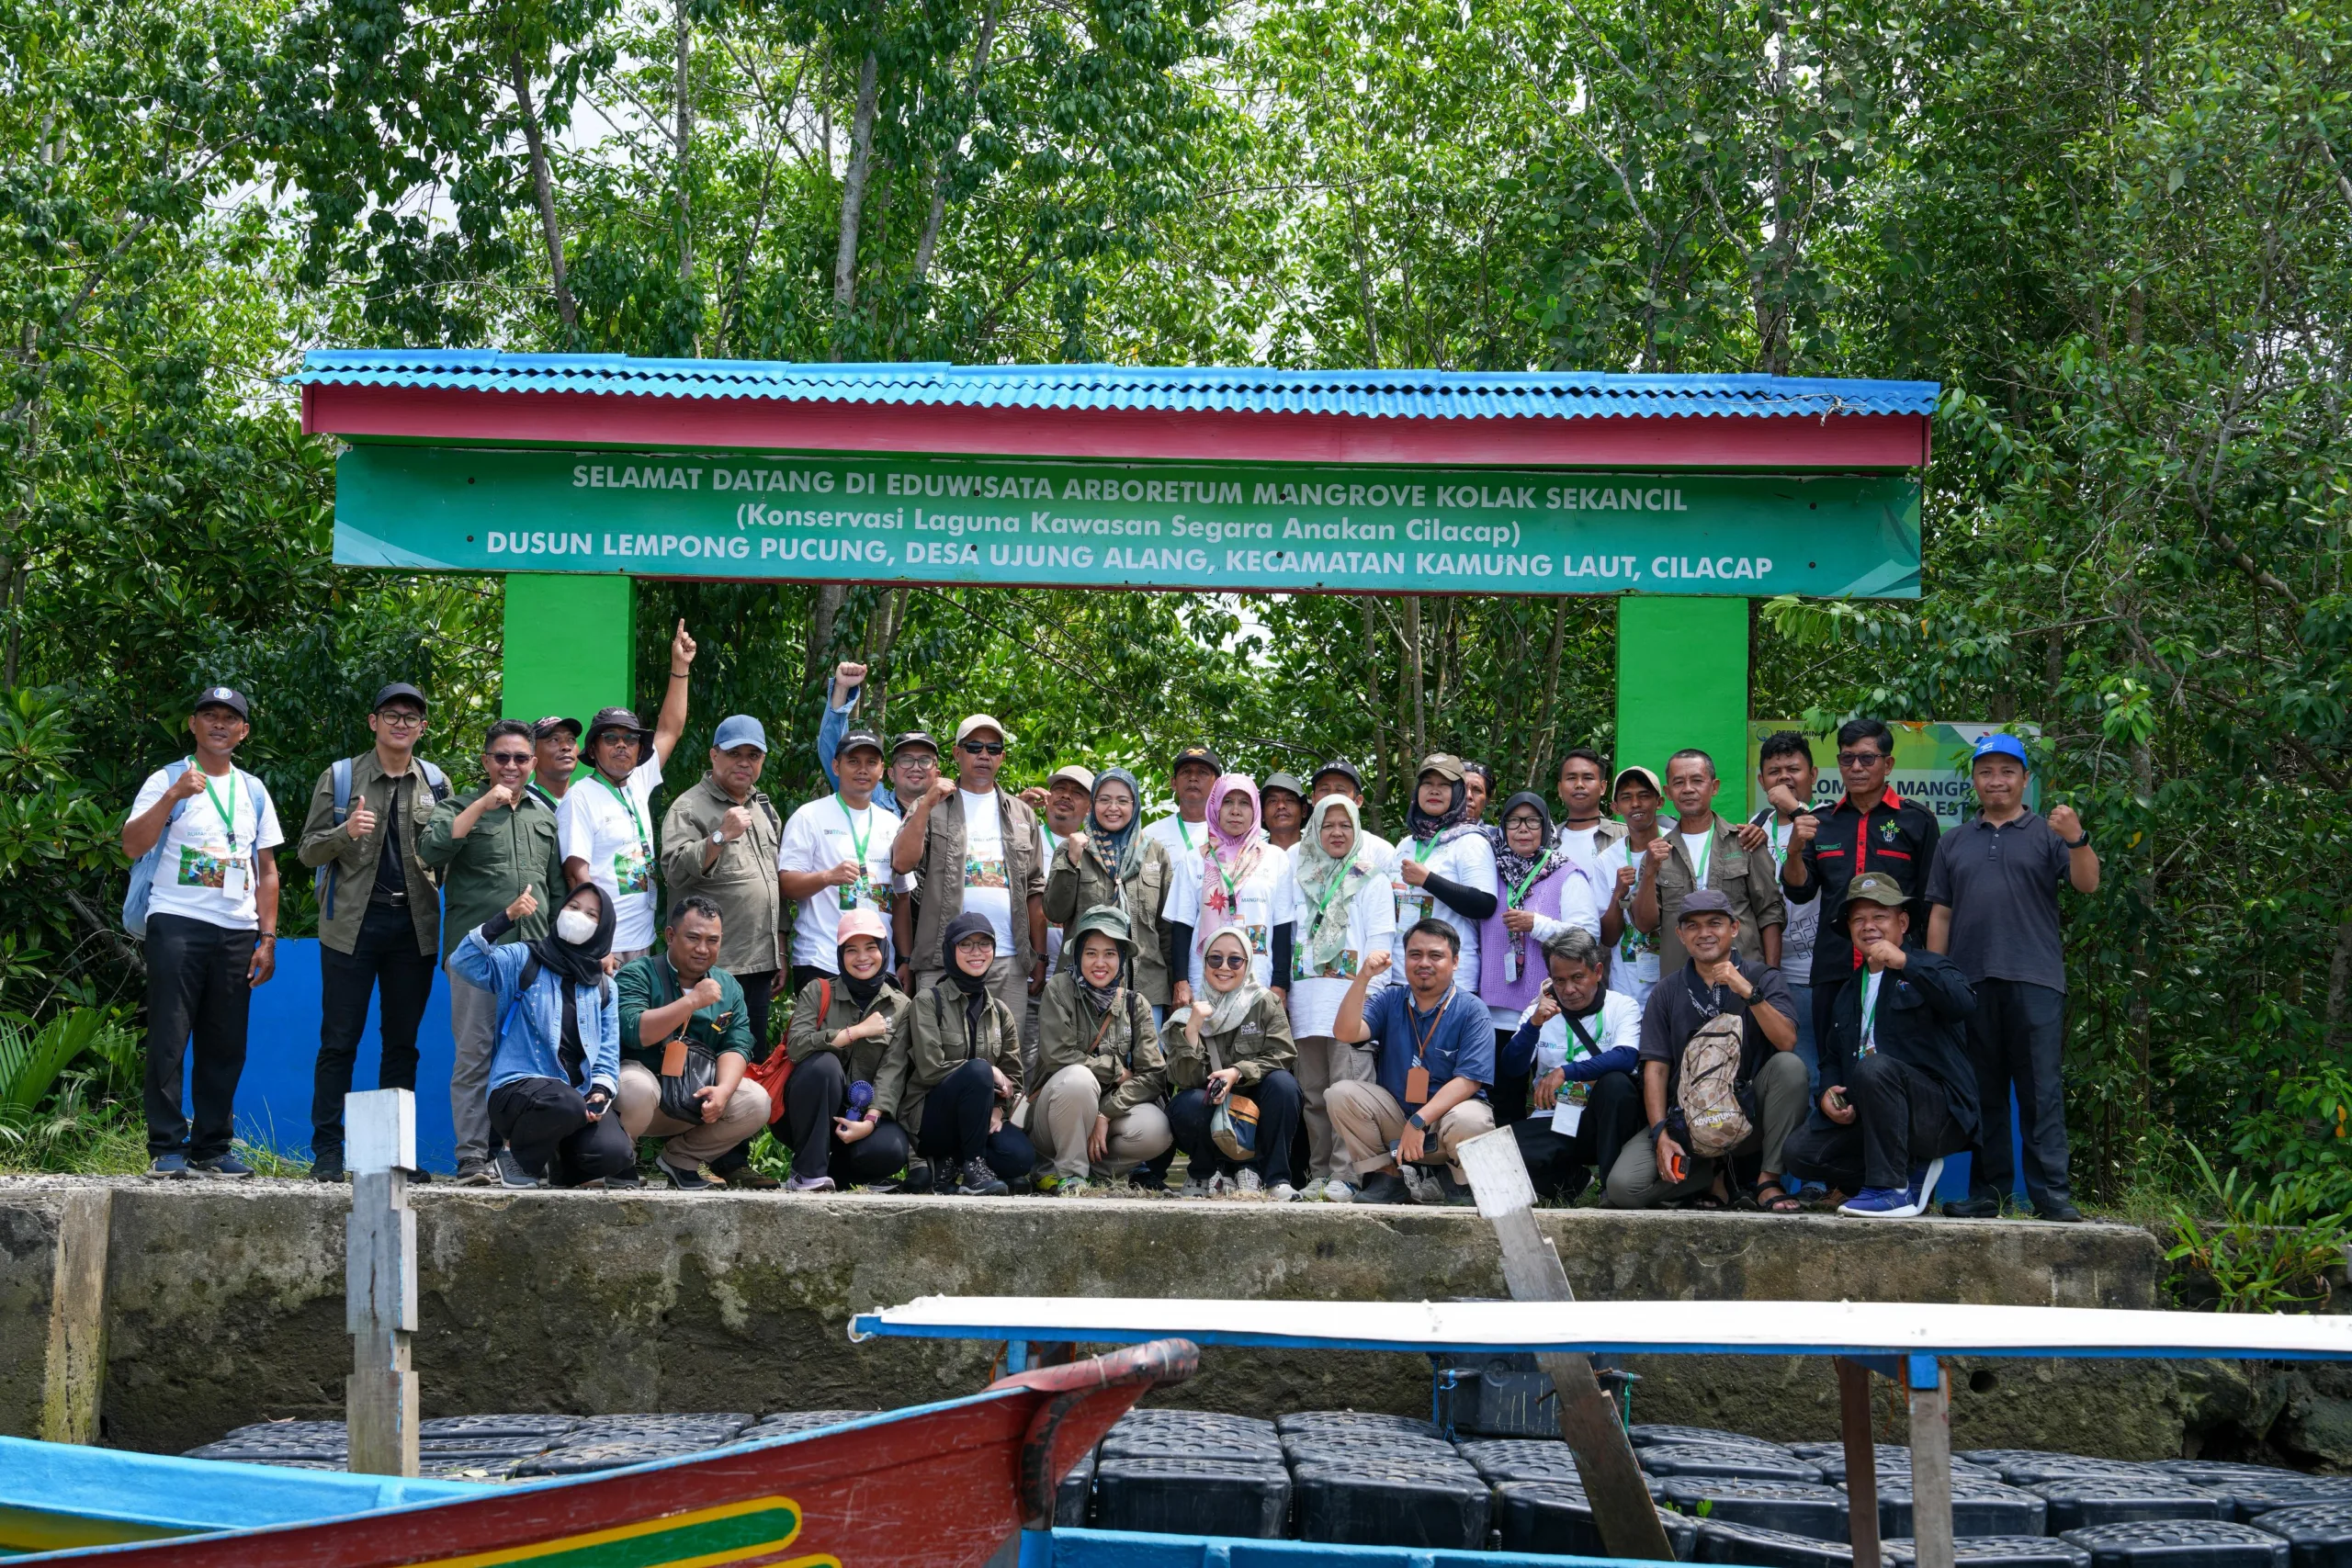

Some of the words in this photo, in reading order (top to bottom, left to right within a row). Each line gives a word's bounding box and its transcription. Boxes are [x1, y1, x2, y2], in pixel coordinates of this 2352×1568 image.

[572, 465, 702, 490] SELAMAT
[713, 468, 835, 493] DATANG
[846, 472, 875, 494] DI
[887, 473, 1054, 500] EDUWISATA
[1061, 479, 1242, 504] ARBORETUM
[1253, 483, 1426, 507] MANGROVE
[1437, 486, 1536, 509] KOLAK
[1546, 488, 1687, 511] SEKANCIL
[737, 503, 904, 530] (Konservasi
[915, 508, 1020, 537] Laguna
[1031, 512, 1161, 536] Kawasan
[1170, 513, 1272, 544] Segara
[1283, 516, 1396, 541] Anakan
[1406, 518, 1521, 548] Cilacap)
[487, 531, 593, 555] DUSUN
[603, 534, 751, 559] LEMPONG
[761, 538, 897, 567] PUCUNG,
[906, 542, 980, 566] DESA
[989, 544, 1094, 569] UJUNG
[1102, 547, 1216, 575] ALANG,
[1227, 549, 1405, 575] KECAMATAN
[1417, 553, 1554, 577] KAMUNG
[1564, 555, 1642, 581] LAUT,
[1652, 557, 1773, 580] CILACAP
[1896, 781, 1972, 796] MANGR
[1694, 1108, 1736, 1127] ADVENTURE
